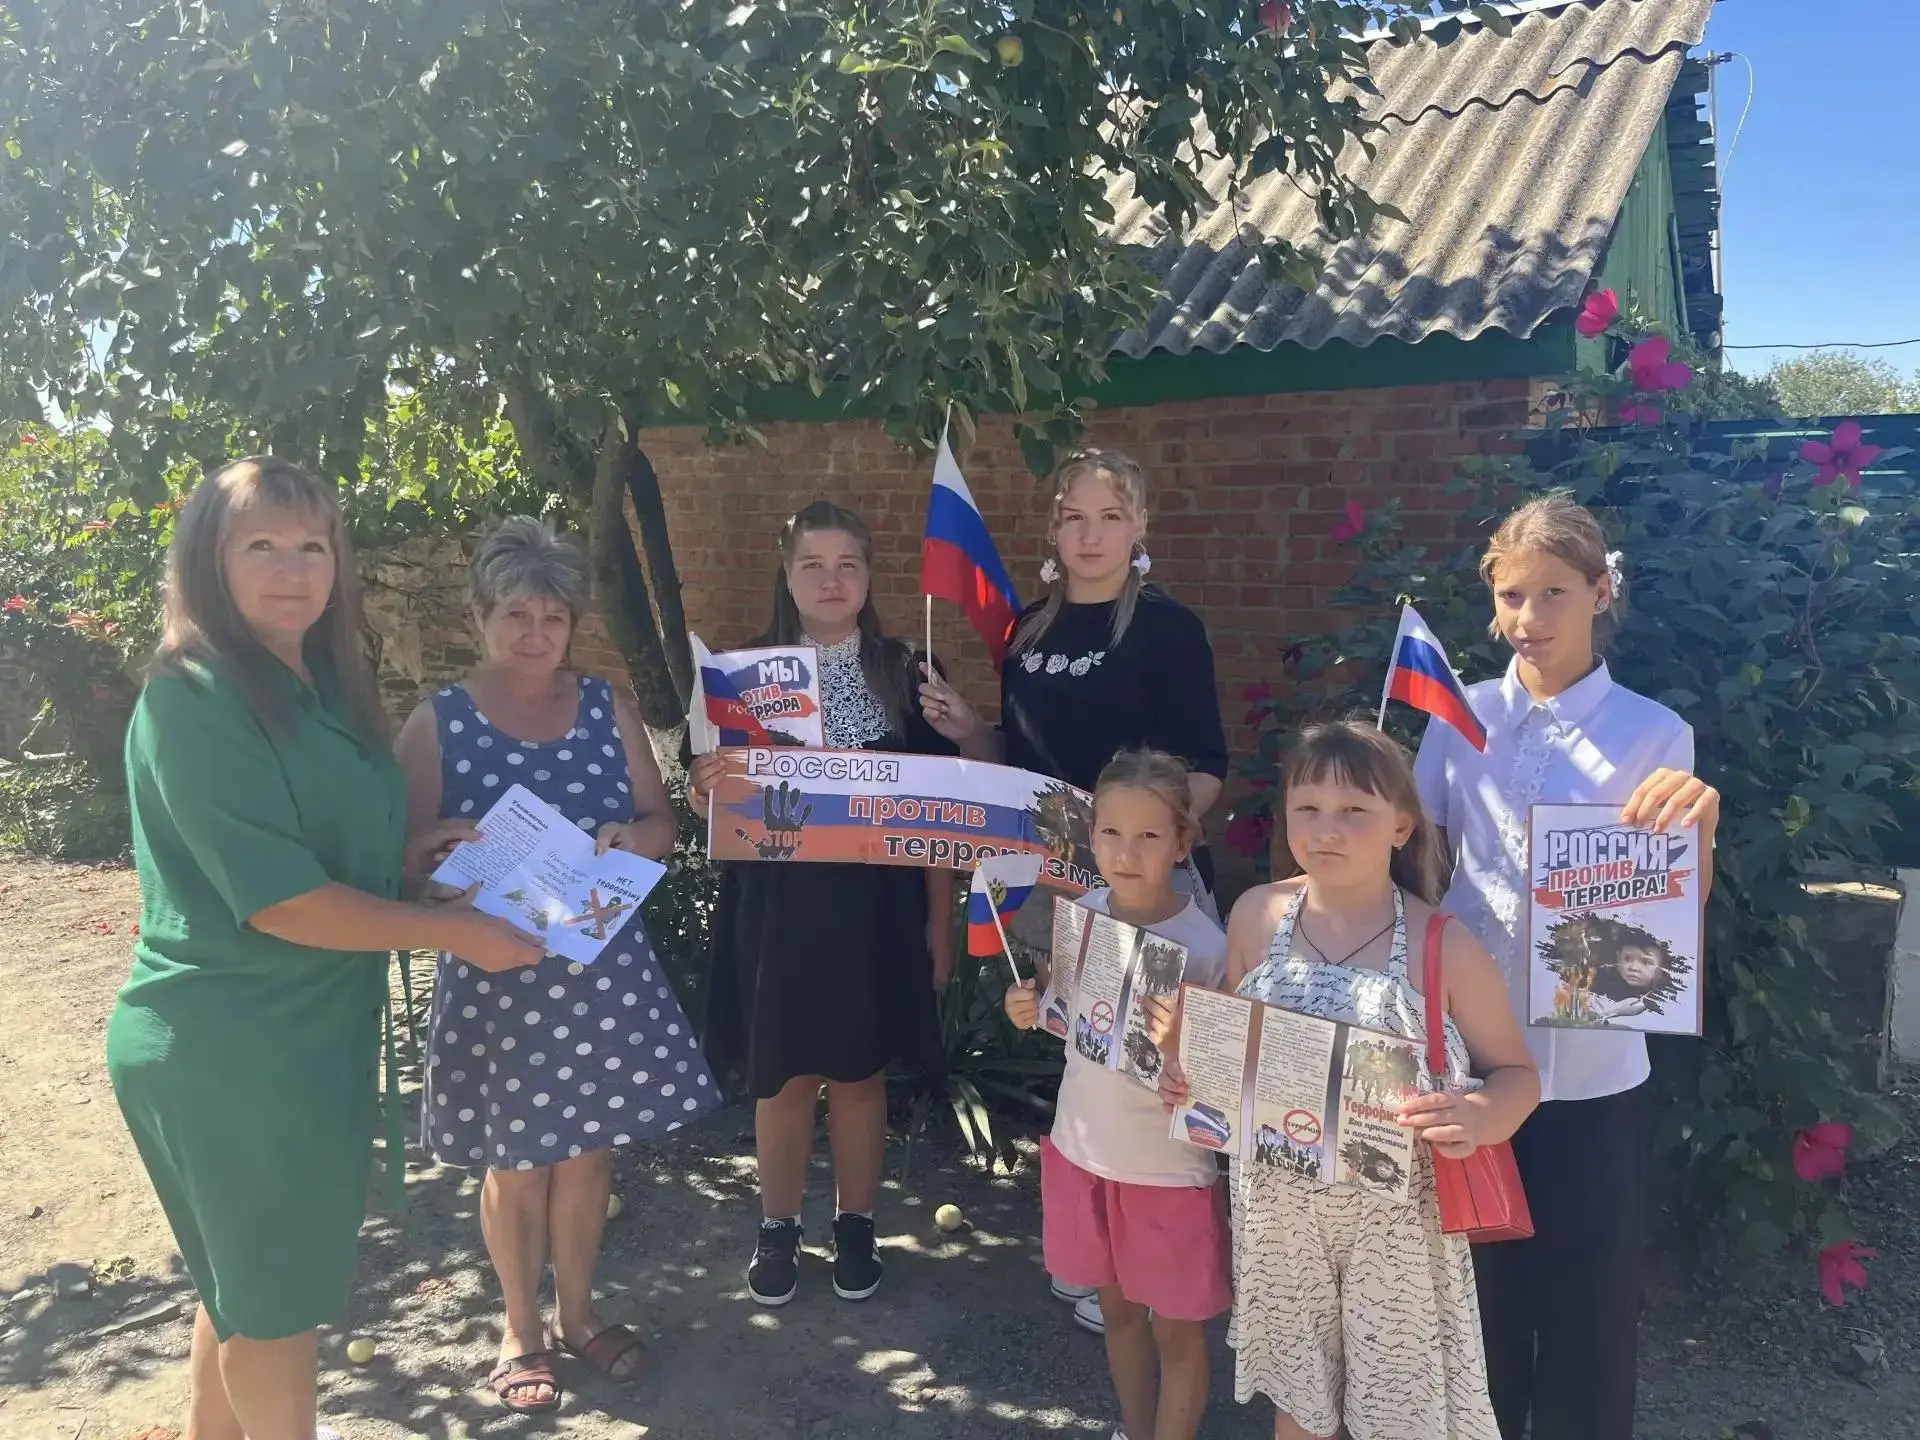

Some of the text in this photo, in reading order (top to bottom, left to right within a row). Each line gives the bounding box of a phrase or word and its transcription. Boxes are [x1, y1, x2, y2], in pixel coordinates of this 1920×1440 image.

[758, 660, 800, 685] МЫ
[741, 684, 783, 705] ОТИВ
[752, 697, 801, 719] РРОРА
[747, 747, 899, 782] Россия
[849, 795, 986, 828] против
[762, 830, 802, 847] STOP
[1548, 830, 1669, 871] РОССИЯ
[884, 835, 1111, 890] террозма
[1549, 859, 1634, 891] ПРОТИВ
[616, 876, 634, 887] НЕТ
[1563, 873, 1668, 909] ТЕРРОРА!
[1343, 1095, 1401, 1123] Террориз
